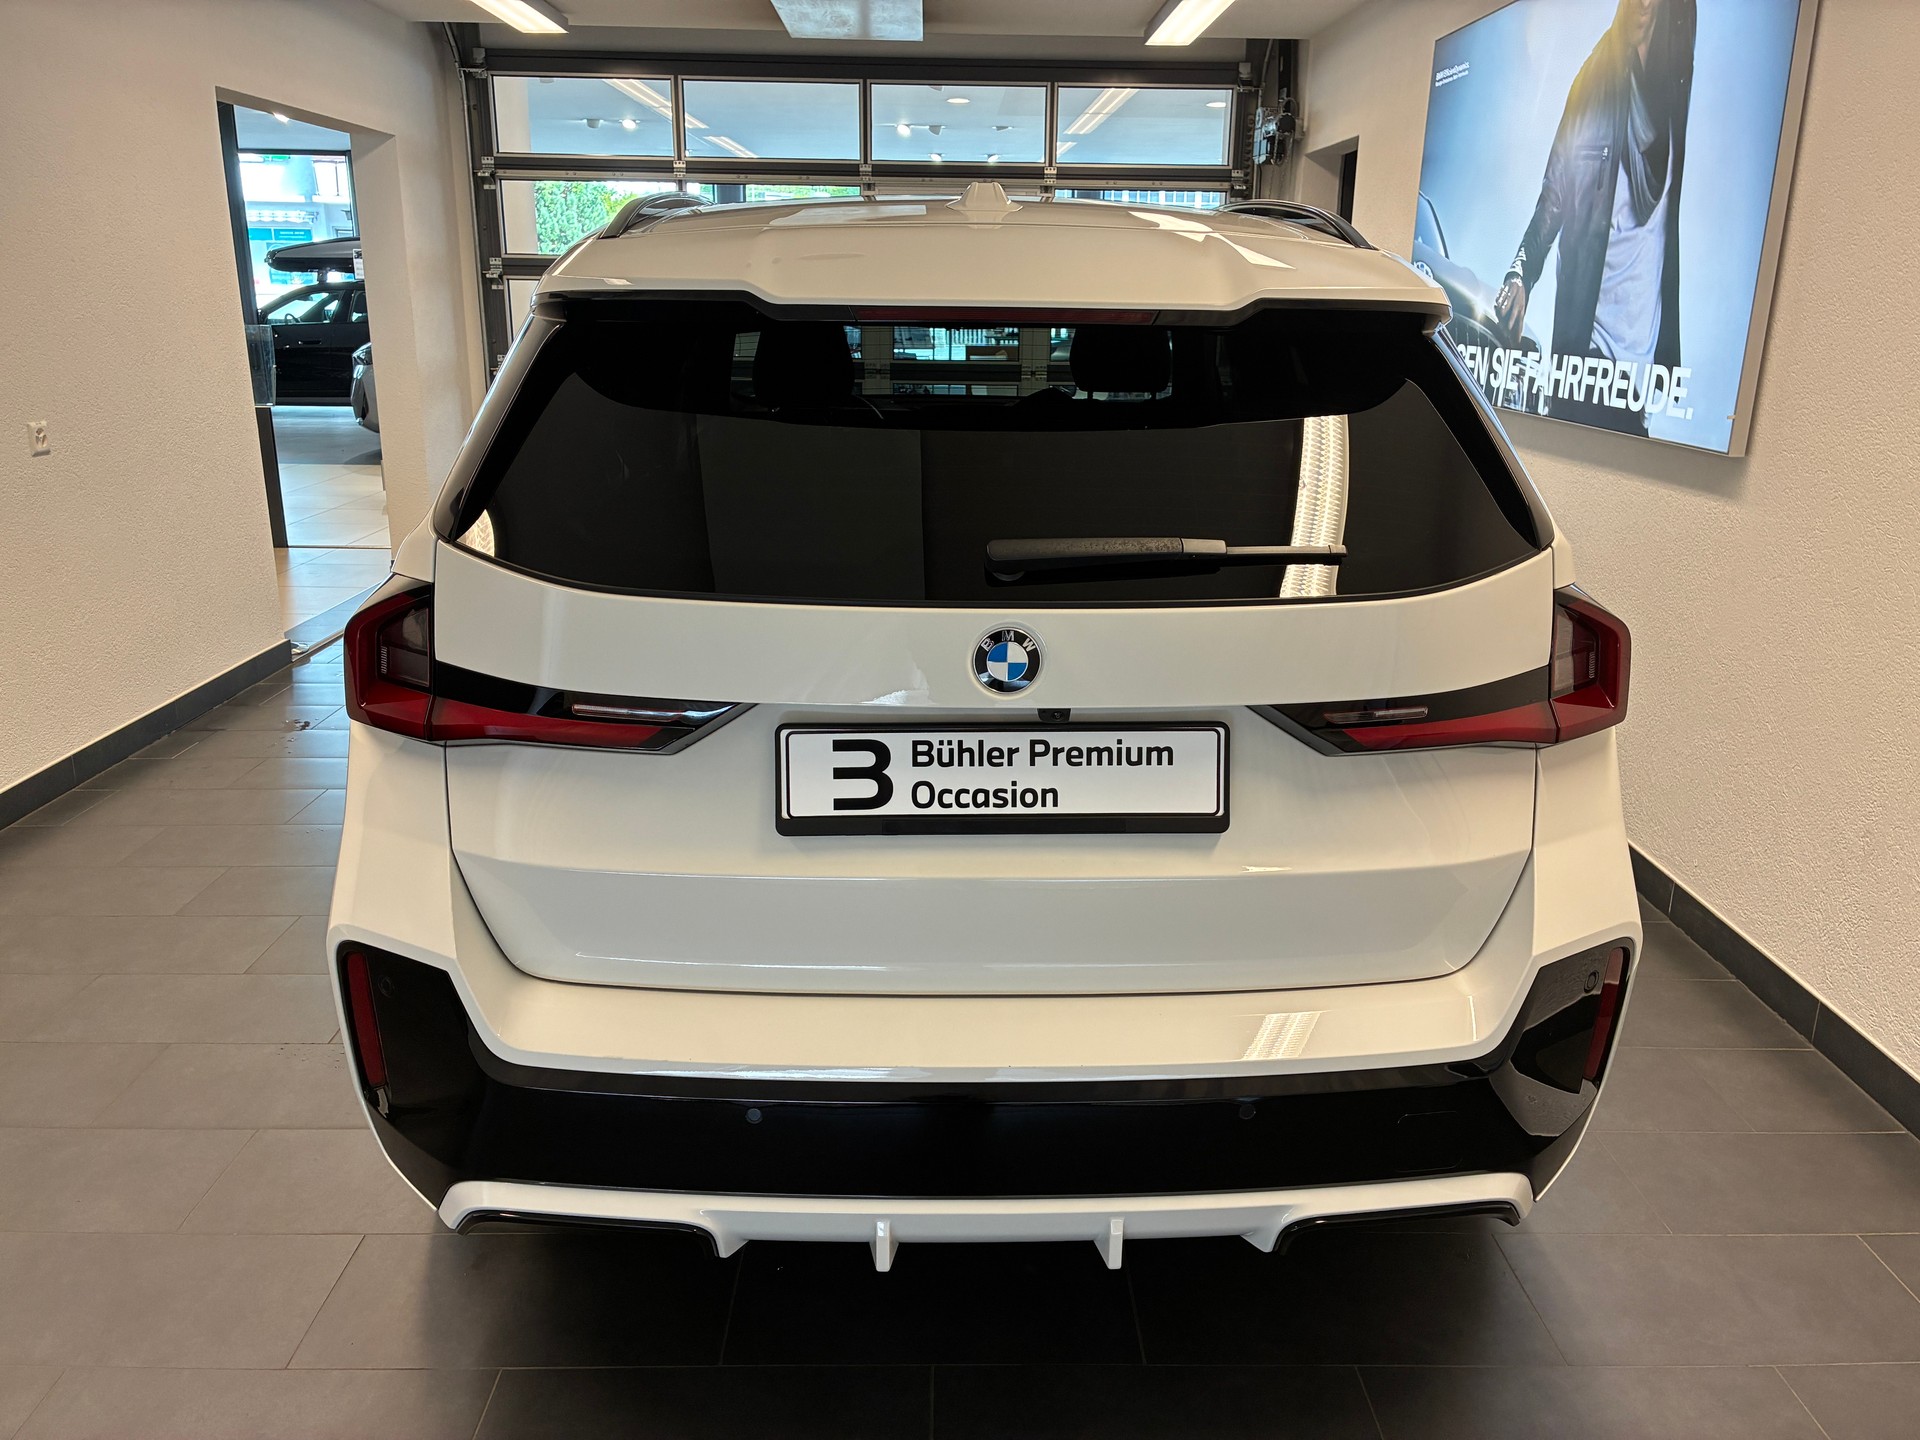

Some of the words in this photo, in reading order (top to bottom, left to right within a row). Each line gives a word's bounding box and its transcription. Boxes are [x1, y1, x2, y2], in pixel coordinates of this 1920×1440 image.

[1490, 348, 1522, 390] SIE
[1523, 351, 1694, 420] FAHRFREUDE.
[980, 630, 1036, 652] BMW
[911, 739, 1019, 768] Bühler
[1029, 739, 1174, 767] Premium
[911, 780, 1059, 809] Occasion
